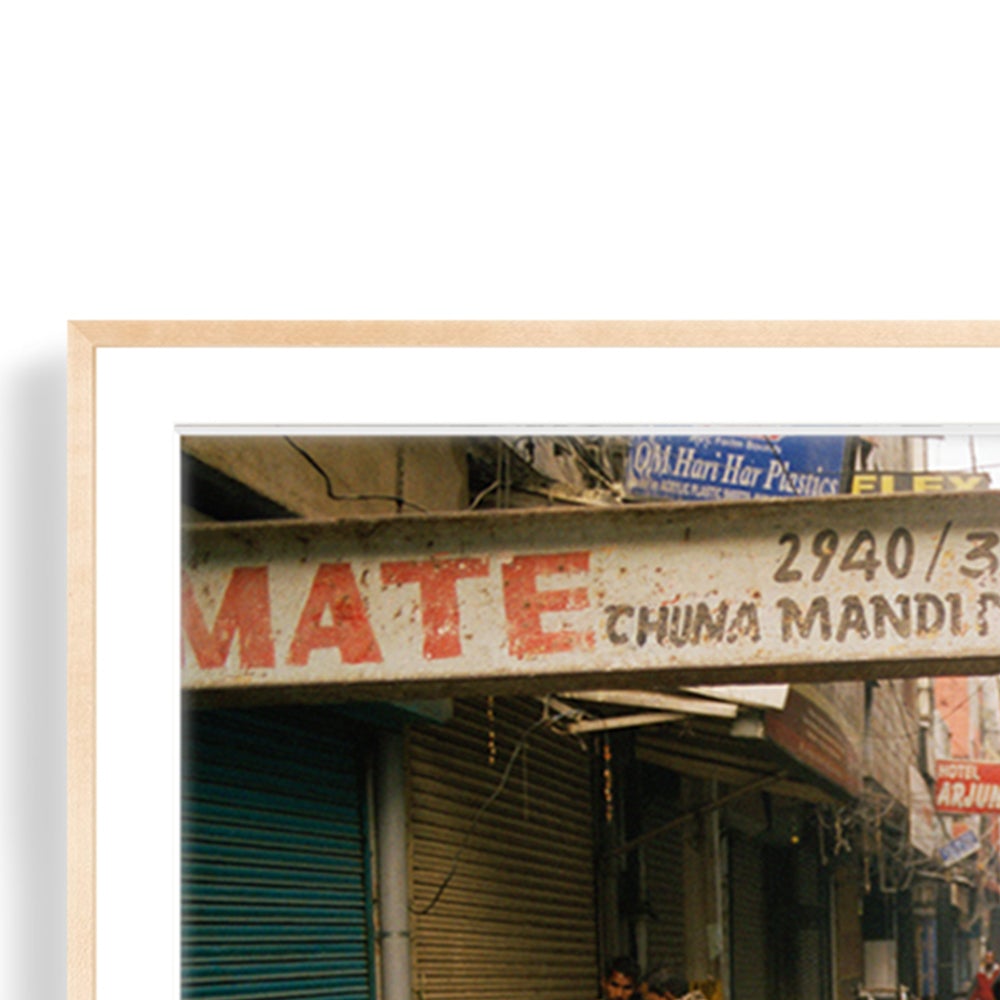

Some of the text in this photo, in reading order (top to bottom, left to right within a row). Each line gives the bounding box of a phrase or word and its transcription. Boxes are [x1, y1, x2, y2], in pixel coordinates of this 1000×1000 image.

[673, 447, 721, 483] Hari
[722, 453, 762, 489] Har
[763, 459, 839, 495] Plastics
[180, 550, 596, 669] MATE
[604, 600, 761, 648] CHUNA
[776, 592, 964, 642] MANDI
[938, 764, 980, 779] HOTEL
